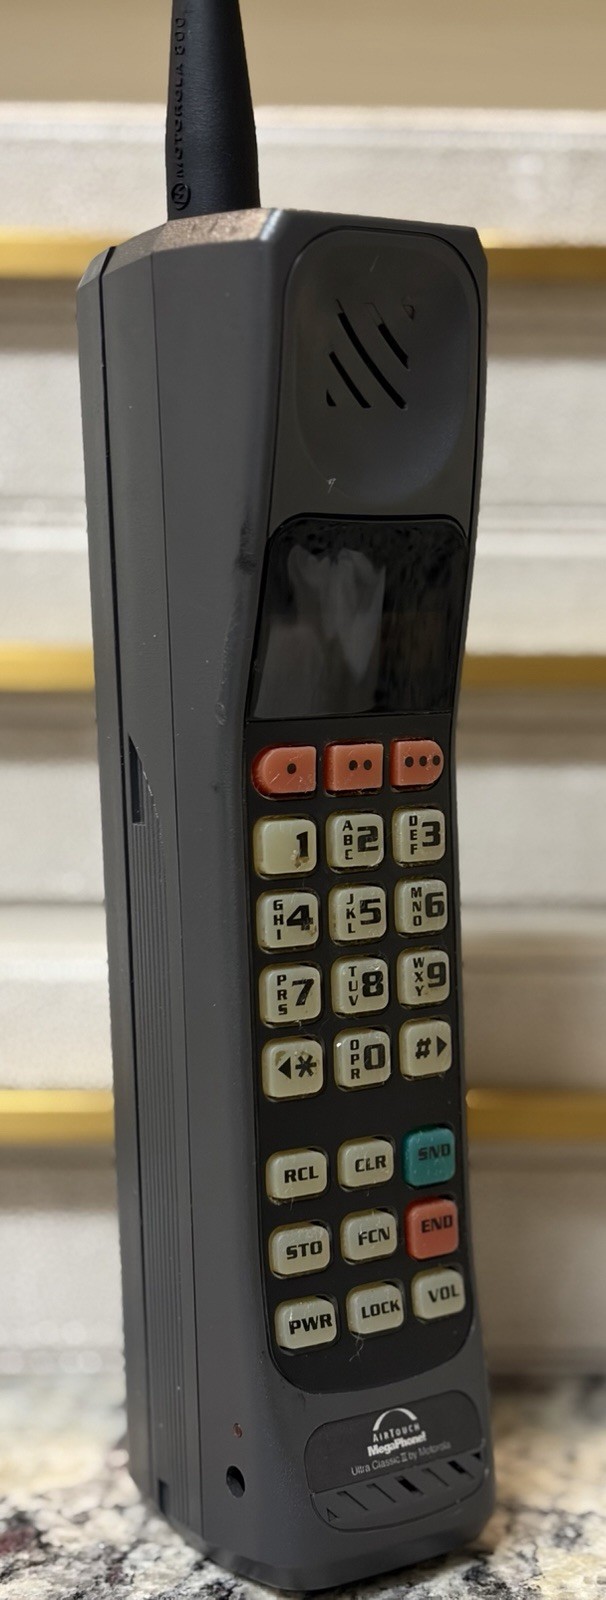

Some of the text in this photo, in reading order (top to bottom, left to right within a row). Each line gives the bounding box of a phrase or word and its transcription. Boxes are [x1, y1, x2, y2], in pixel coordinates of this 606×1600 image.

[174, 63, 185, 179] MOTOROLA
[296, 831, 309, 859] 1
[357, 825, 379, 852] 2
[422, 821, 441, 847] 3
[286, 905, 313, 931] 4
[360, 898, 381, 925] 5
[425, 892, 445, 918] 6
[362, 971, 384, 997] 8
[427, 961, 447, 988] 9
[291, 978, 315, 1006] 7
[363, 1043, 386, 1071] 0
[355, 1155, 387, 1173] CLR
[418, 1143, 451, 1161] SND
[284, 1165, 319, 1184] RCL
[358, 1226, 391, 1246] FCN
[421, 1215, 453, 1233] END
[286, 1240, 323, 1260] STO
[428, 1284, 460, 1304] VOL
[361, 1299, 402, 1319] LOCK
[289, 1313, 333, 1335] PWR
[351, 1464, 371, 1476] Ultra
[372, 1455, 400, 1470] Classic
[408, 1449, 418, 1462] by
[418, 1441, 452, 1458] Motorola
